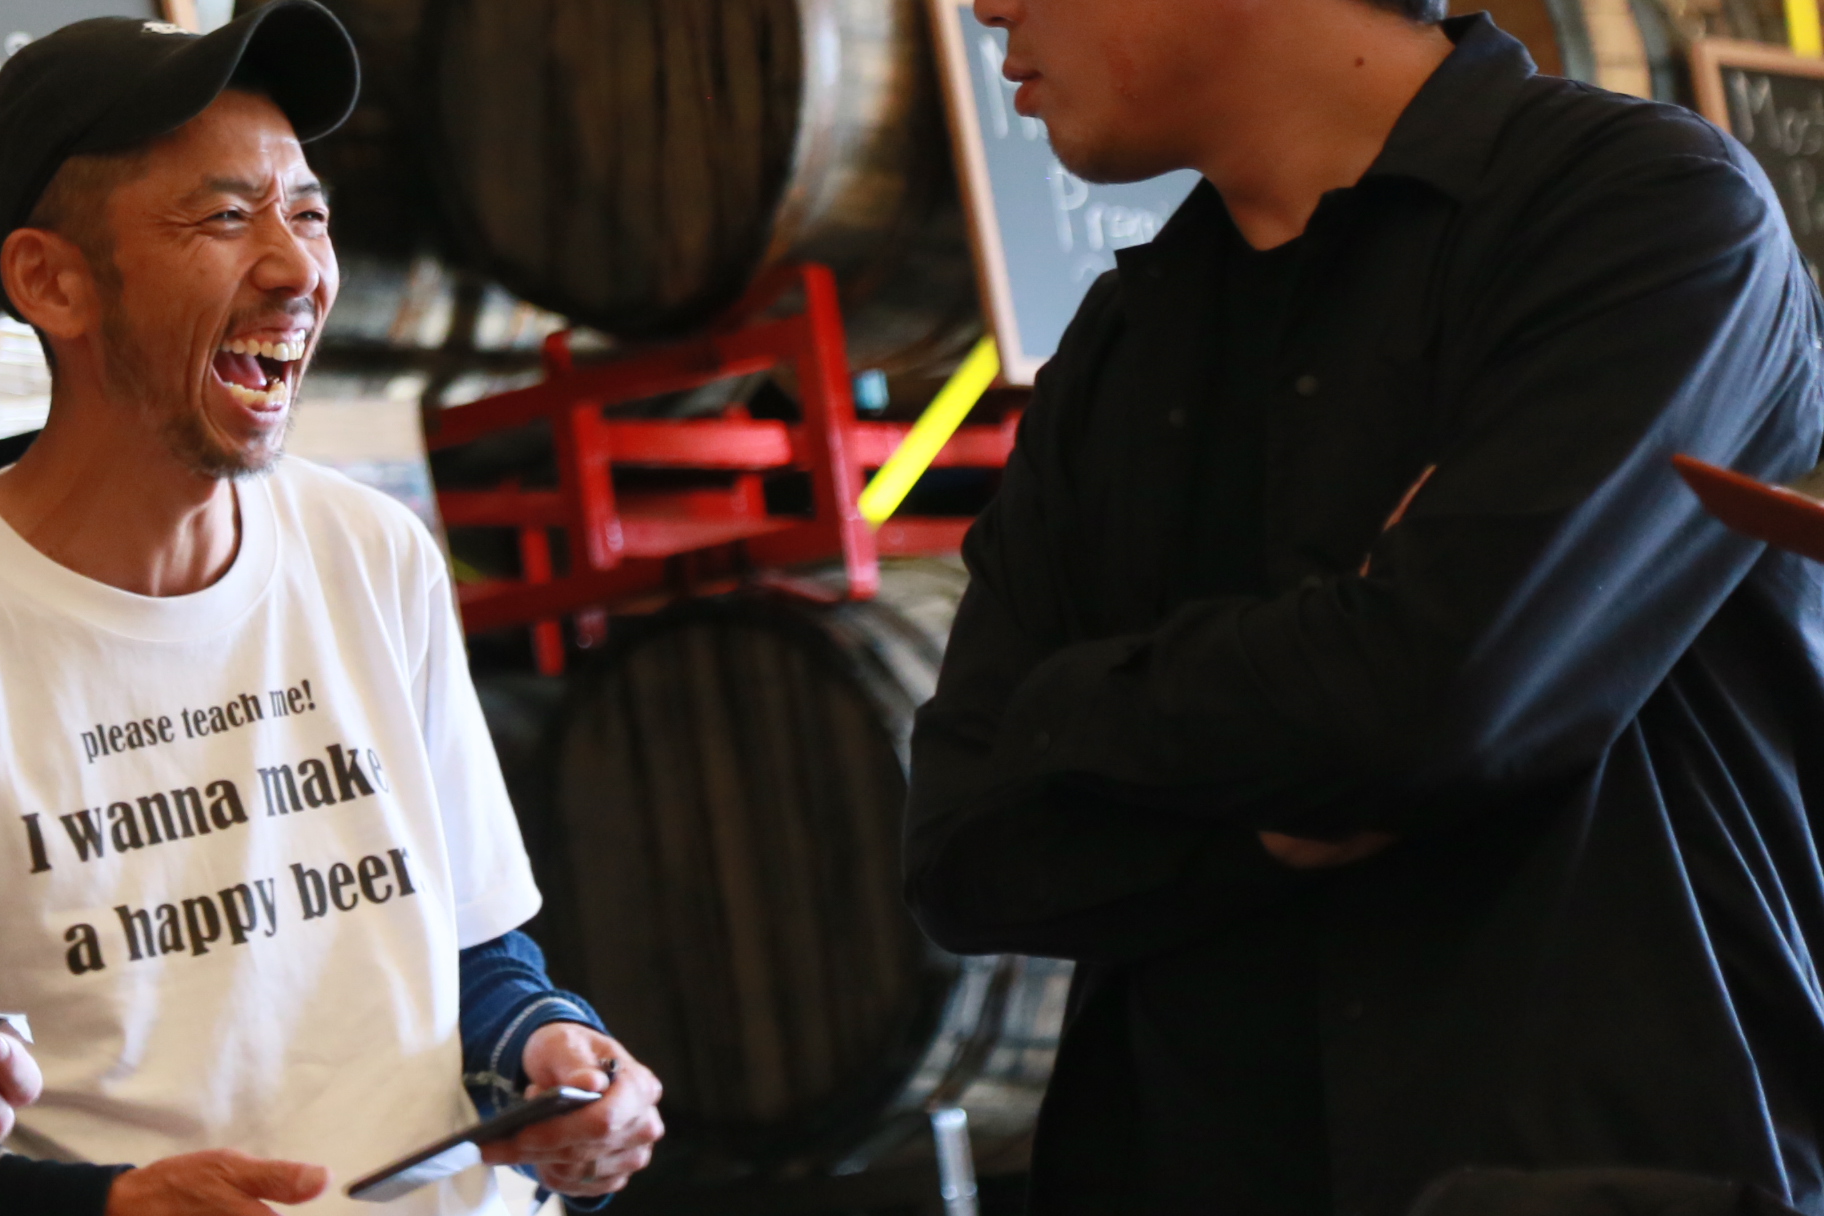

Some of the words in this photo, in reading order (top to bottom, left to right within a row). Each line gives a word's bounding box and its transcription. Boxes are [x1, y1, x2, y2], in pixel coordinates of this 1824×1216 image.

[81, 711, 175, 764] please
[182, 693, 264, 739] teach
[269, 679, 318, 719] me!
[21, 812, 52, 874] I
[60, 779, 249, 863] wanna
[257, 743, 391, 817] make
[63, 920, 106, 976] a
[114, 877, 278, 962] happy
